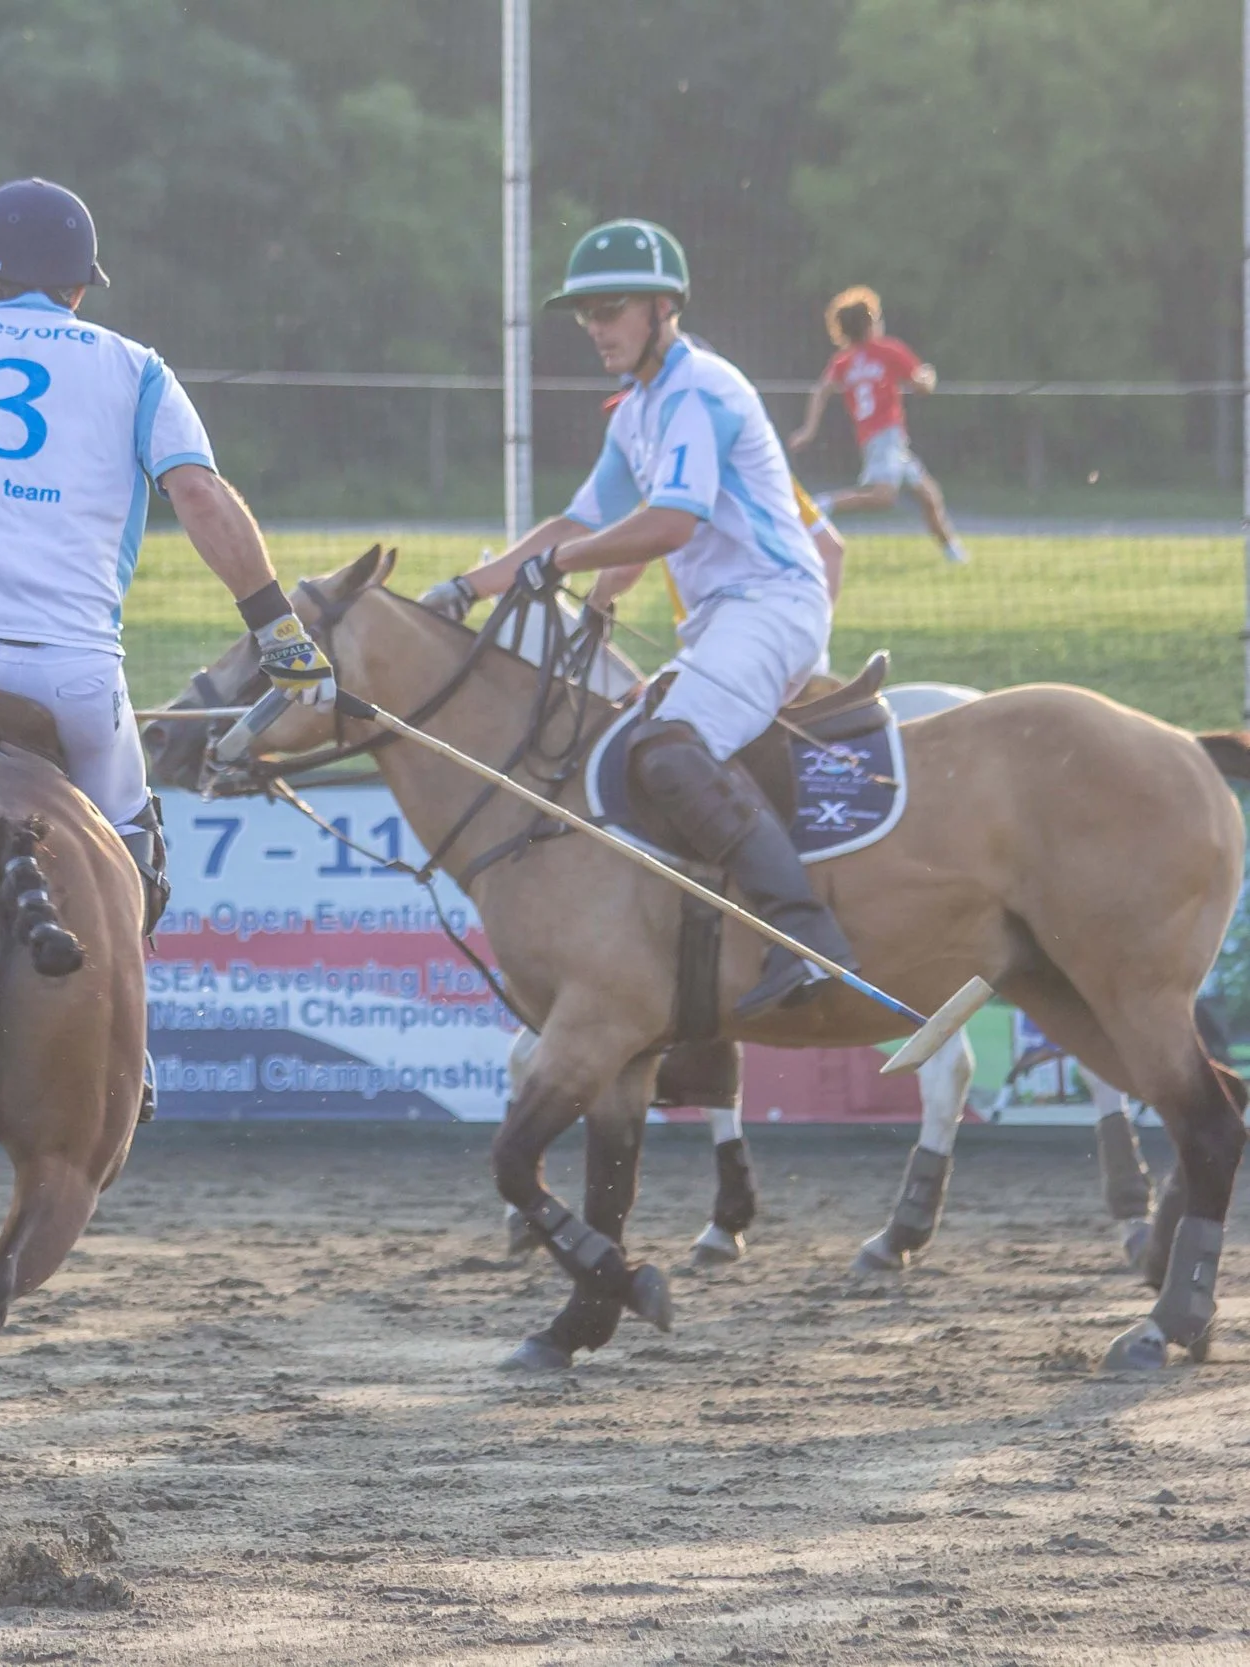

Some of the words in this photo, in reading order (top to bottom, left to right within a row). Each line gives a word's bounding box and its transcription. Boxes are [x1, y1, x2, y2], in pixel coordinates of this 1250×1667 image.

[663, 443, 690, 490] 1
[3, 478, 61, 503] team
[193, 816, 242, 878] 7
[317, 816, 415, 878] 11
[211, 902, 303, 941] Open
[314, 902, 468, 939] Eventing
[230, 963, 420, 998] Developing
[151, 1000, 289, 1030] National
